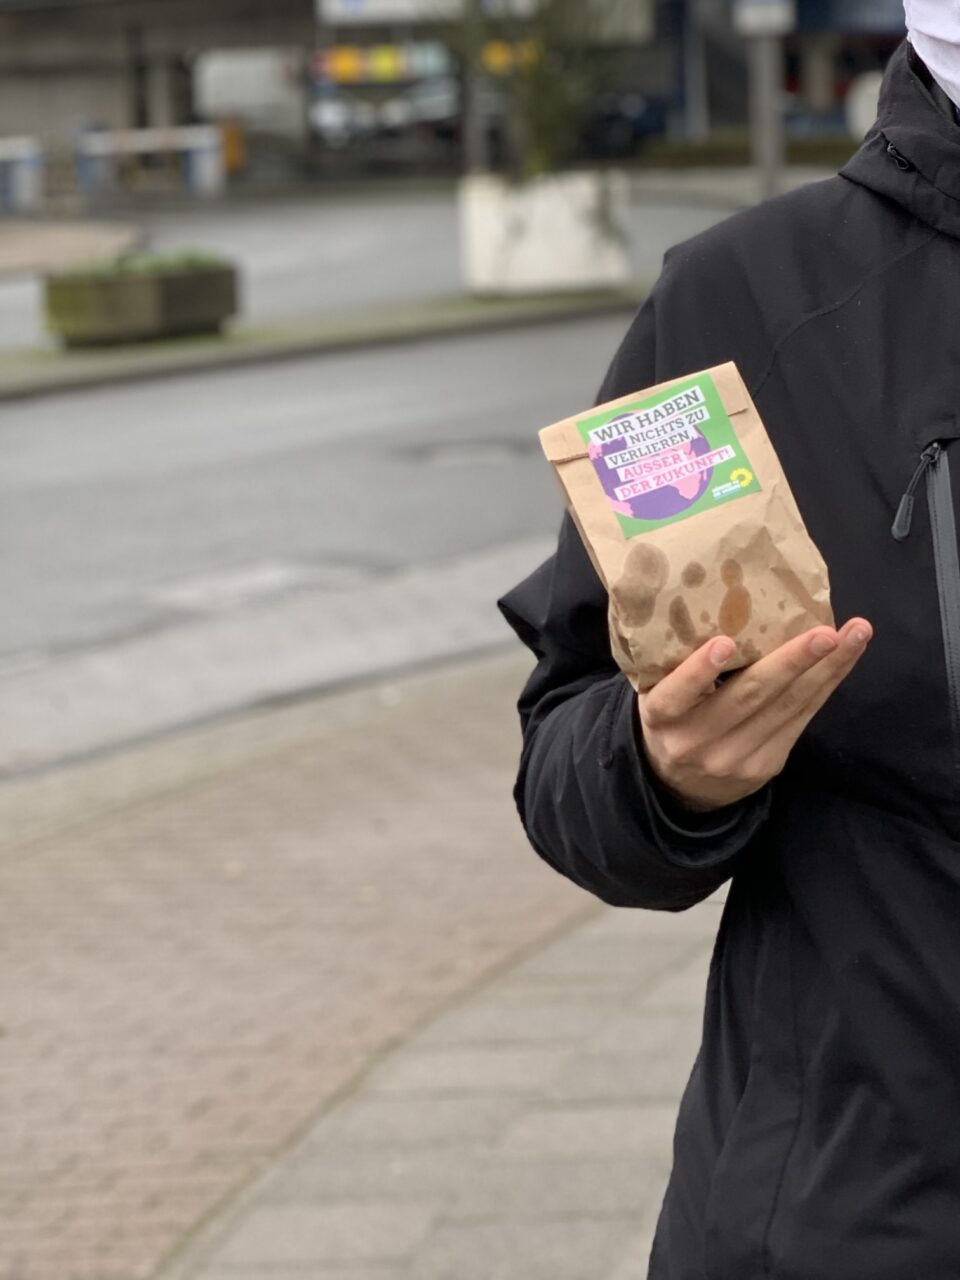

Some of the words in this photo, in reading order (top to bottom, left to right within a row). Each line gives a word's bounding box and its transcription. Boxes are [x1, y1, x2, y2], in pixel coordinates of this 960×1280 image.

[593, 419, 635, 442] WIR
[636, 389, 700, 426] HABEN
[629, 417, 685, 445] NICHTS
[685, 409, 705, 425] ZU
[620, 479, 652, 498] DER
[652, 447, 730, 486] ZUKUNFT!
[623, 452, 684, 480] AUSSER
